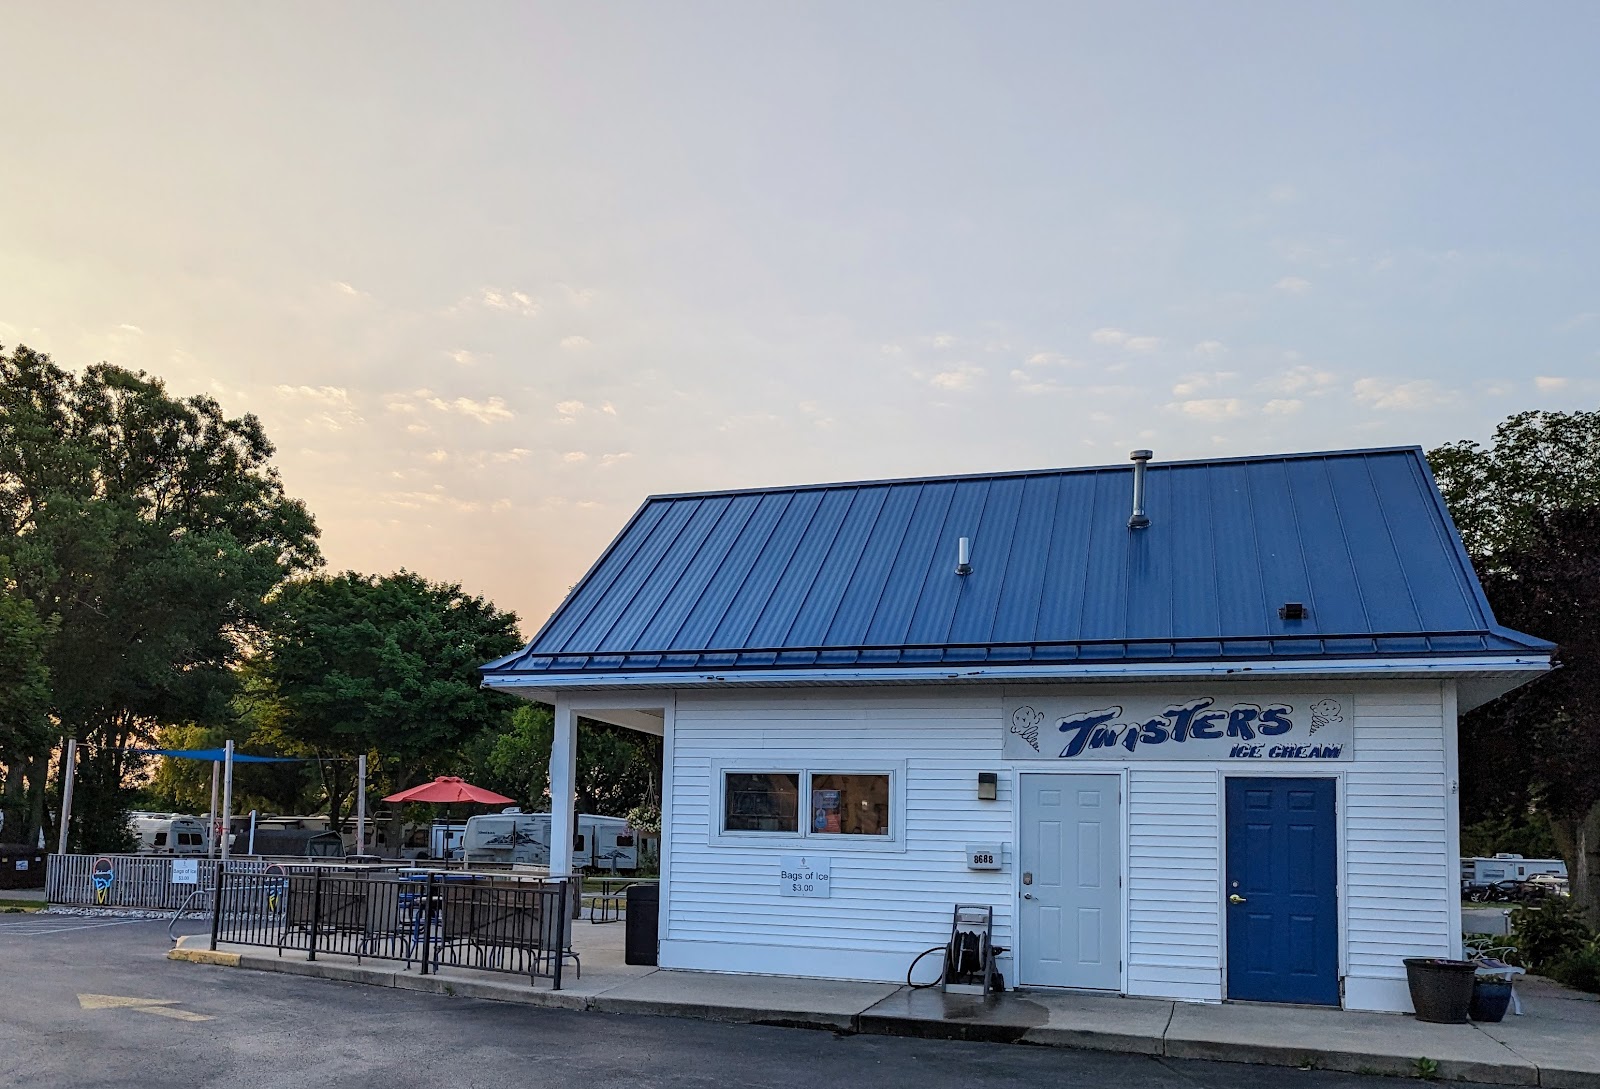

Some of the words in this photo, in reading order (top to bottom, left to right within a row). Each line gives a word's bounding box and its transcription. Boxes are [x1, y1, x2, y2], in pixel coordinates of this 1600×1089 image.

[1055, 697, 1294, 759] TWISTERS
[1229, 743, 1265, 758] ICE
[1268, 743, 1343, 759] CREAM
[973, 854, 994, 864] 8688
[781, 870, 803, 882] Bags
[804, 871, 814, 880] of
[816, 871, 829, 881] Ice
[792, 883, 814, 892] $3.00
